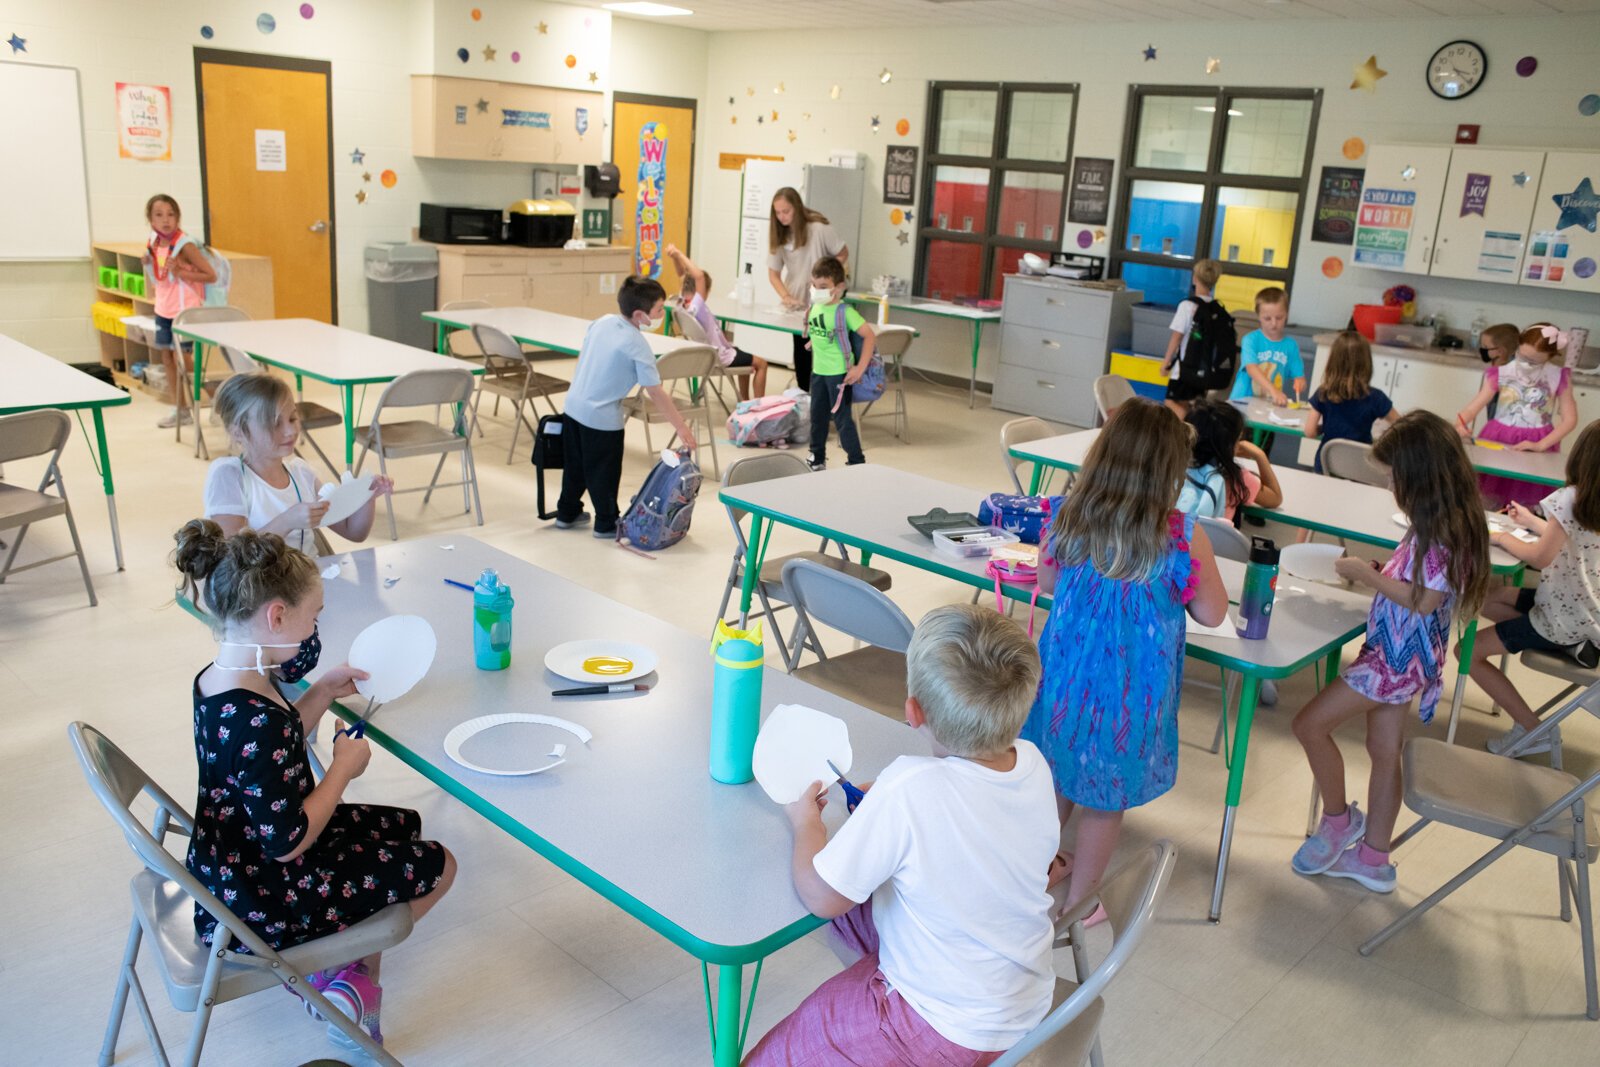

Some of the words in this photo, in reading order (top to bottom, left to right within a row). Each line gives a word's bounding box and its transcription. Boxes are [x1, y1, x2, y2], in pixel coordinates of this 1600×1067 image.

[1457, 47, 1465, 56] 12
[887, 174, 911, 194] BIG
[1466, 185, 1488, 198] JOY
[639, 140, 665, 260] Welcome
[1372, 191, 1389, 203] YOU
[1363, 207, 1409, 225] WORTH
